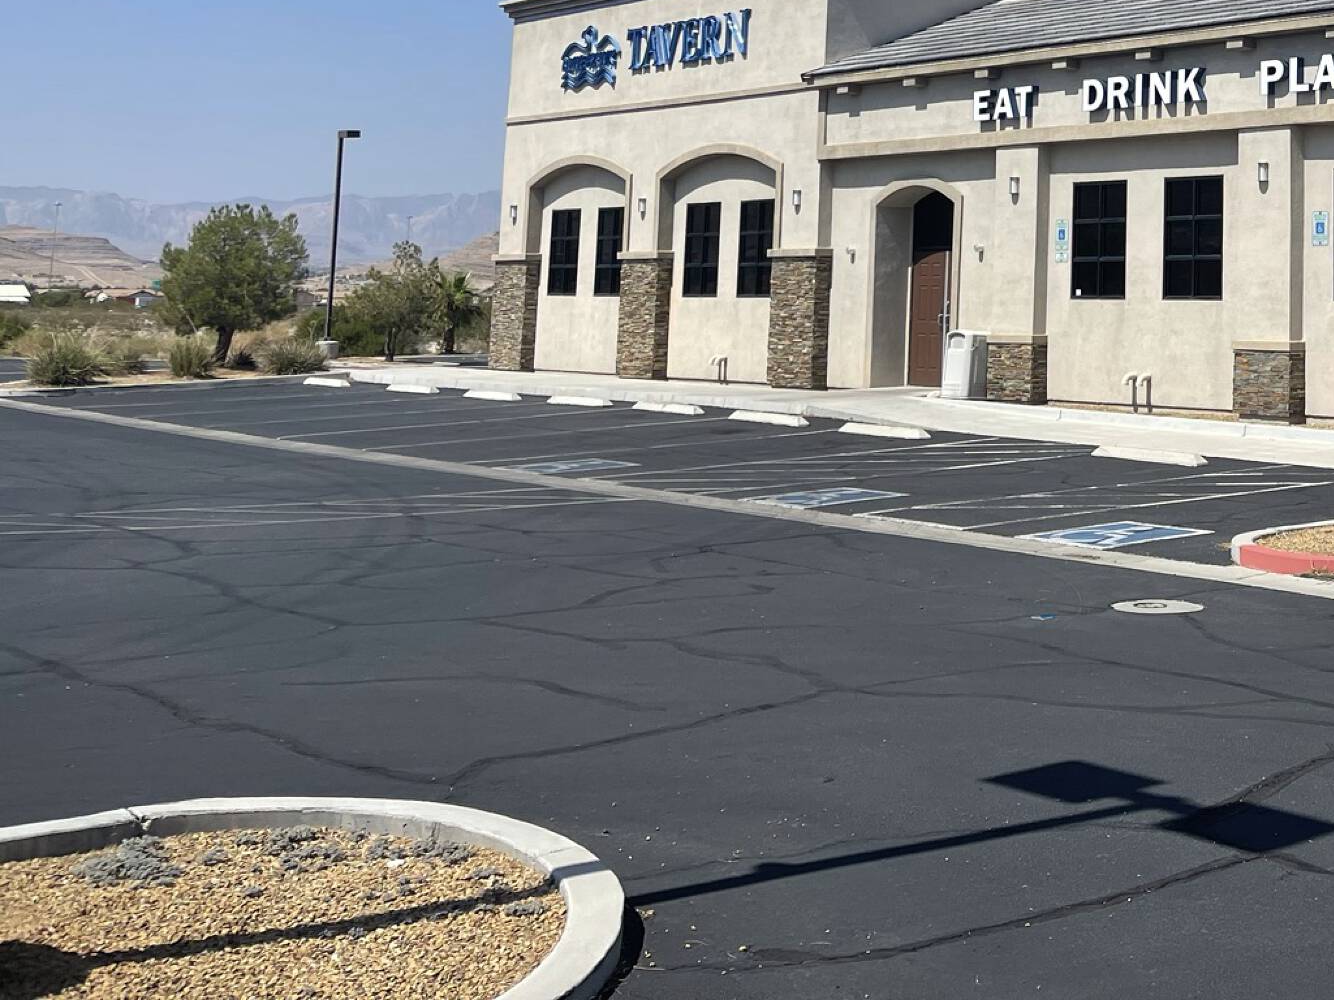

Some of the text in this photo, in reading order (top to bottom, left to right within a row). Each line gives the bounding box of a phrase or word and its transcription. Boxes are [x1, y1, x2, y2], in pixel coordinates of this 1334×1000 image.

[626, 8, 752, 72] TAVERN
[972, 85, 1035, 122] EAT
[1081, 67, 1204, 112] DRINK
